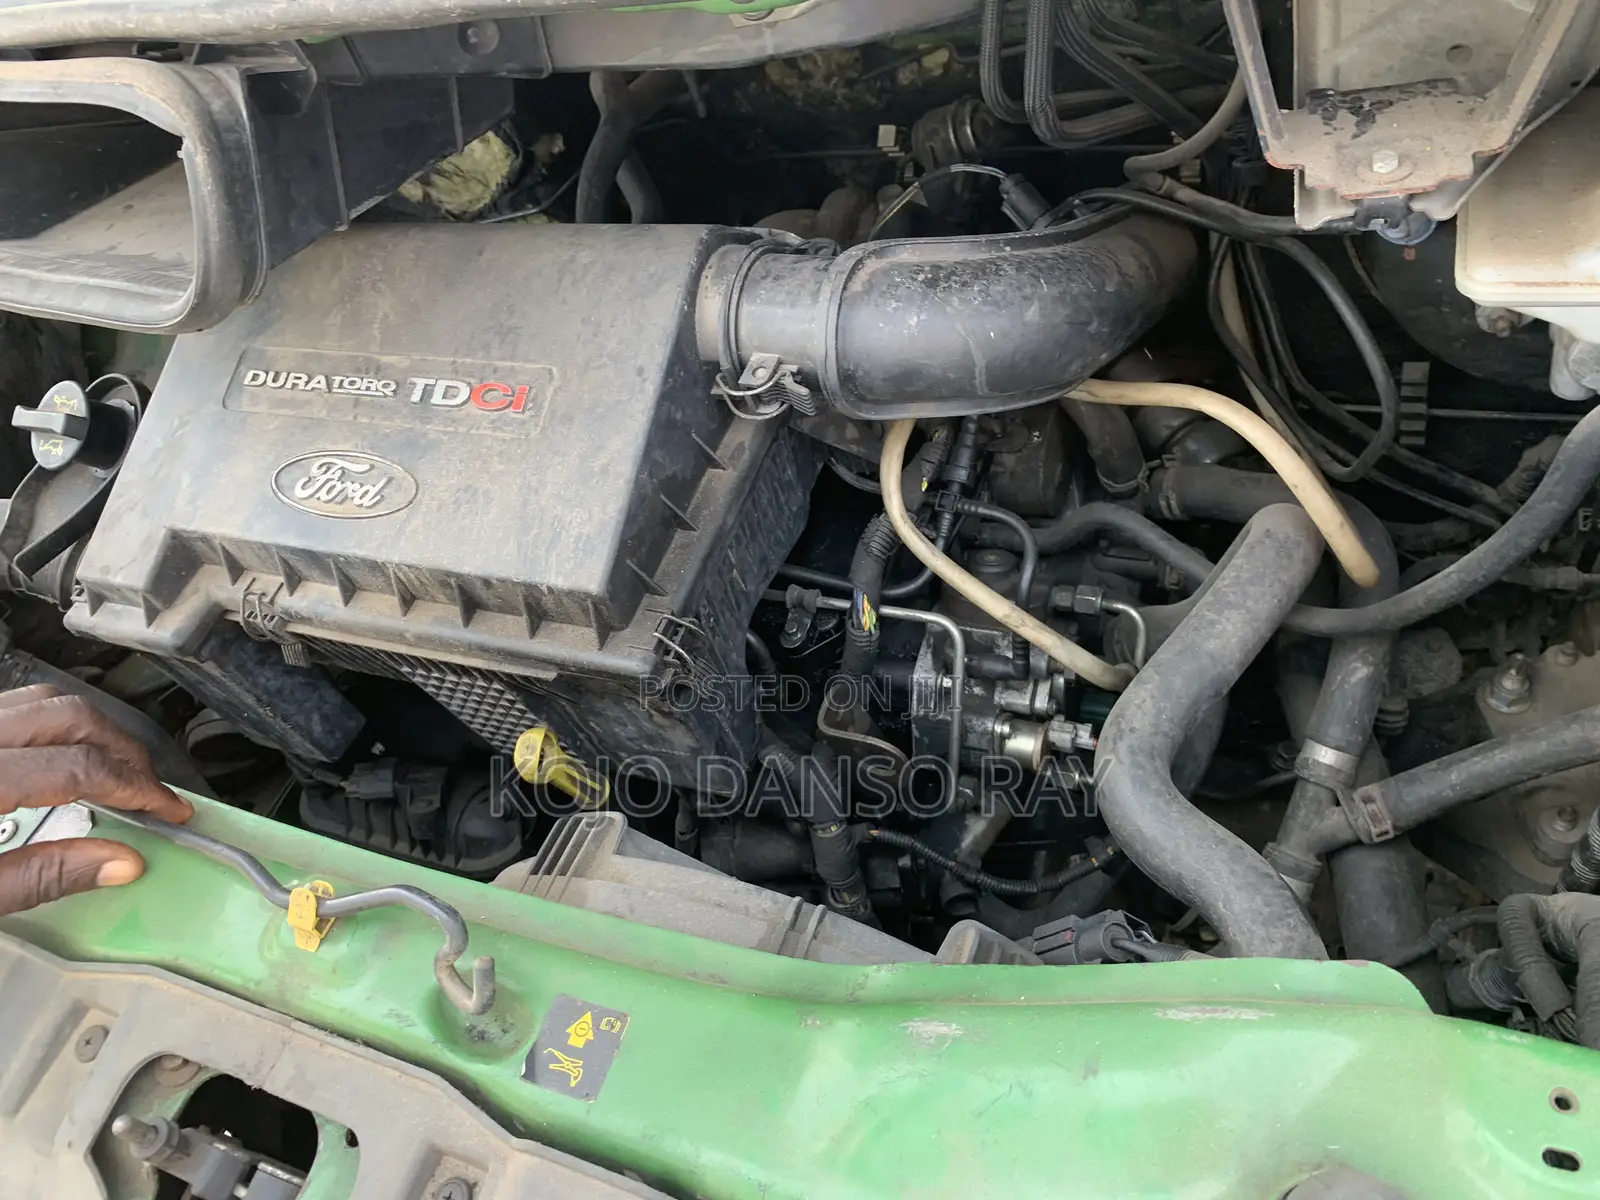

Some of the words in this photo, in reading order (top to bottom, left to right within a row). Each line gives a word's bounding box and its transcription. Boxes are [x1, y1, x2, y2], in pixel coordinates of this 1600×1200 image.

[243, 369, 399, 397] DURATORQ
[407, 376, 531, 413] TDCi
[293, 456, 391, 509] Ford
